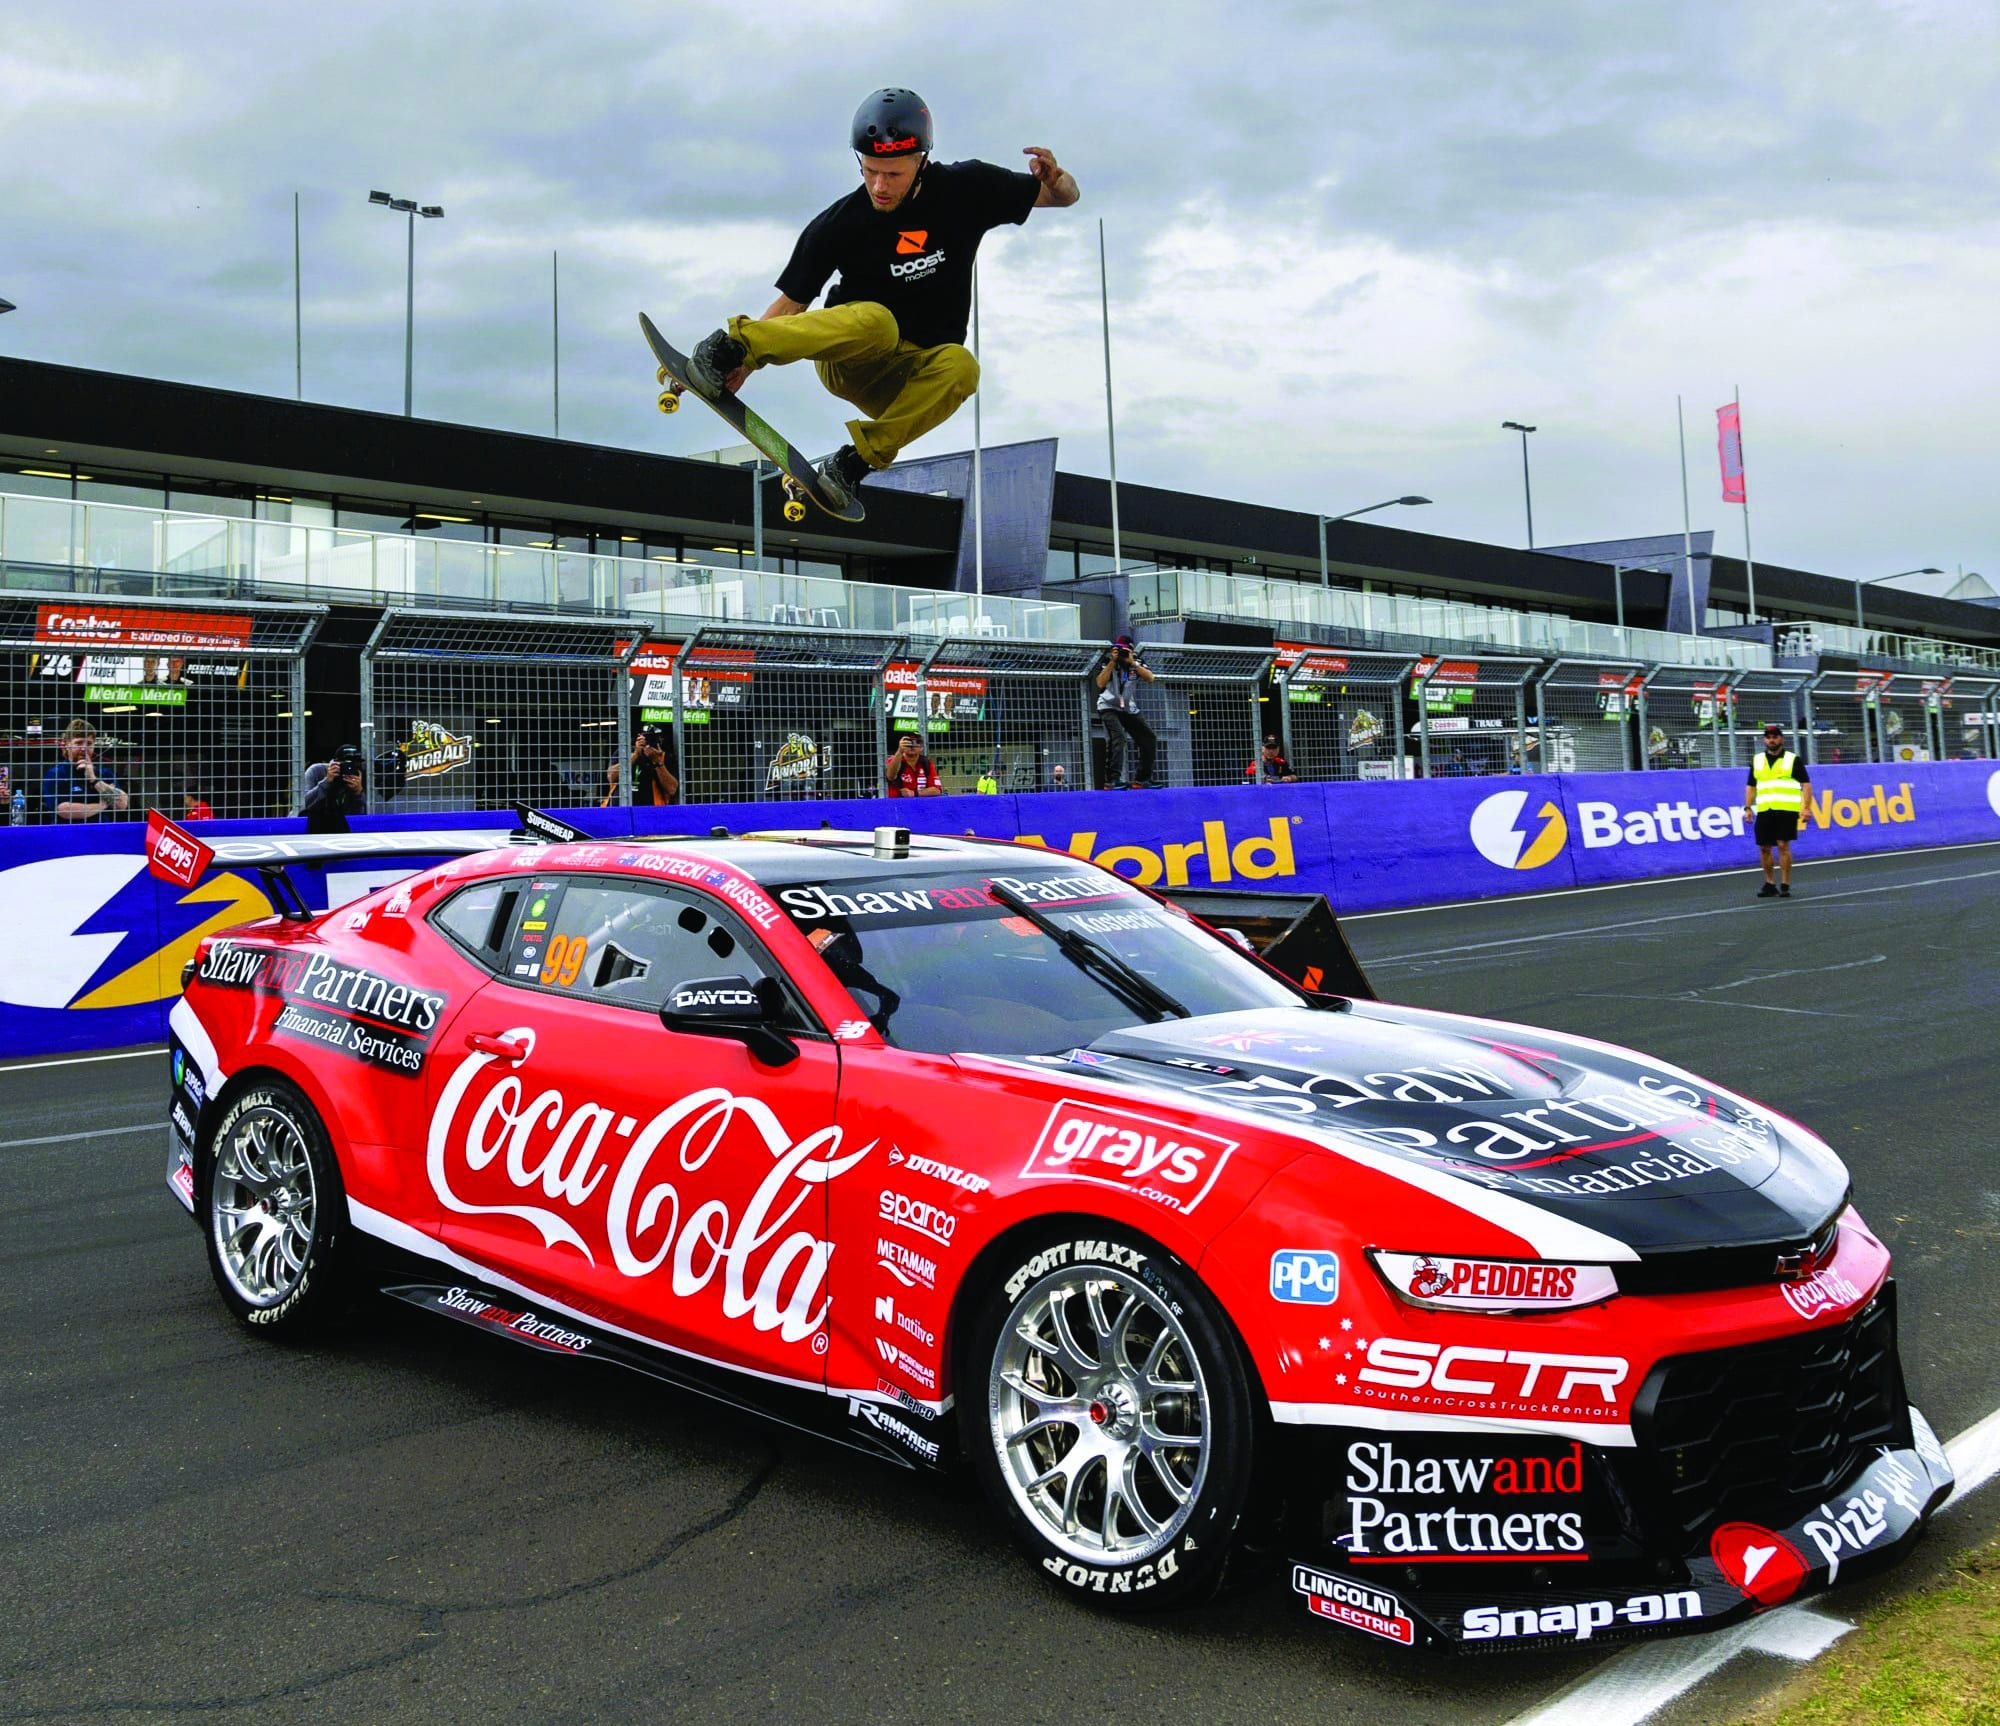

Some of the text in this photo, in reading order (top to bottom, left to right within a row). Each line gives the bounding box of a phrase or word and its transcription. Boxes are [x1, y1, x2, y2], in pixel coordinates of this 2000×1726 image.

[873, 136, 918, 153] boost
[890, 248, 946, 278] boost
[905, 267, 936, 283] mobile
[47, 613, 122, 639] Coates
[40, 654, 73, 676] 26
[885, 667, 918, 685] oates
[89, 686, 182, 703] Merlin Merlin
[527, 811, 574, 842] SUPERCHEAP
[1577, 801, 1756, 849] Batter
[158, 837, 193, 868] grays
[633, 853, 708, 880] KOSTECKI
[721, 877, 782, 930] RUSSELL
[540, 933, 588, 987] 99
[672, 990, 758, 1008] DAYCO
[276, 1004, 422, 1072] Financial Services
[1044, 1118, 1207, 1184] grays
[426, 1026, 880, 1343] Coca-Cola
[904, 1152, 991, 1194] DUNLOP
[879, 1189, 956, 1239] sparco
[1131, 1185, 1181, 1210] .com
[877, 1238, 937, 1283] METAMARK
[1004, 1240, 1148, 1303] SPORT MAXX
[1275, 1255, 1336, 1298] PPG
[1451, 1262, 1576, 1298] PEDDERS
[898, 1350, 935, 1379] WORKWEAR
[898, 1360, 935, 1390] DISCOUNTS
[1357, 1337, 1630, 1403] SCTR
[900, 1390, 936, 1421] Repco
[848, 1396, 940, 1457] RAMPAGE
[1346, 1497, 1585, 1553] Partners
[1804, 1488, 1888, 1586] Pizza
[1042, 1547, 1180, 1594] DUNLOP
[1299, 1571, 1391, 1617] LINCOLN
[1320, 1600, 1402, 1638] ELECTRIC
